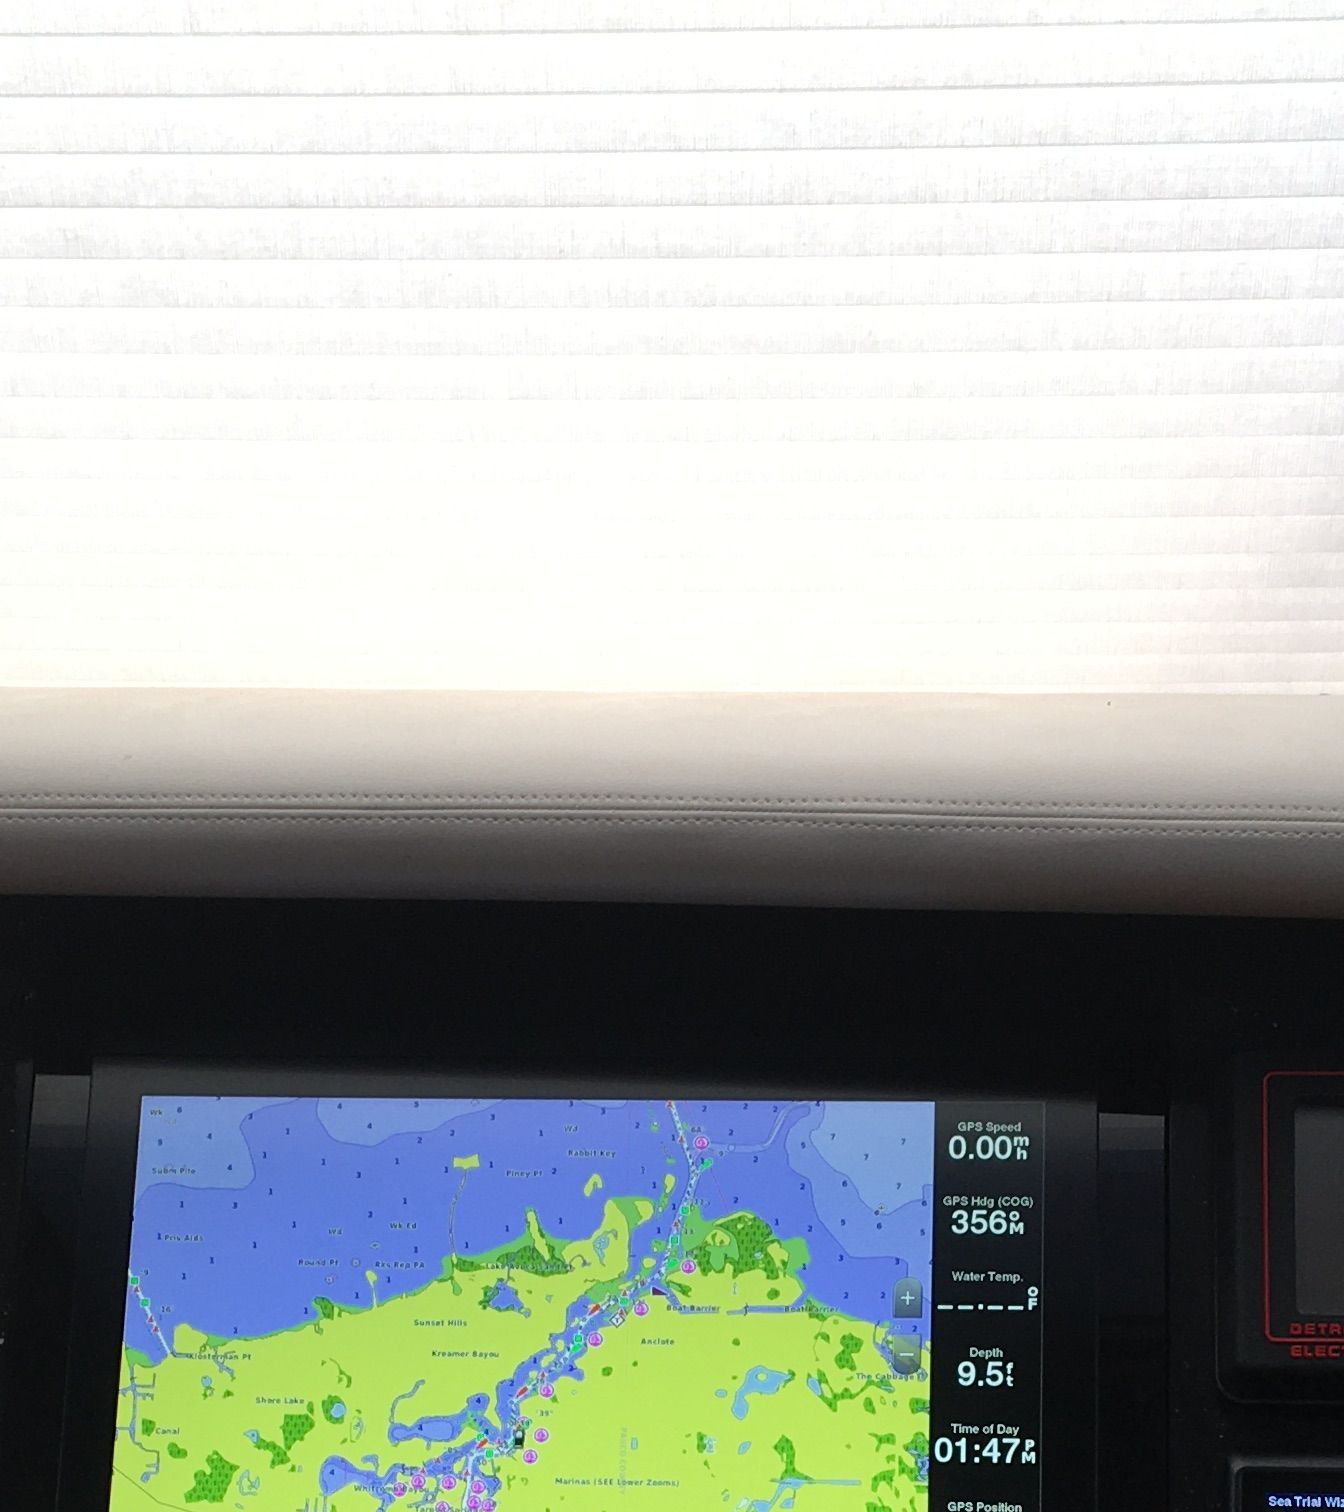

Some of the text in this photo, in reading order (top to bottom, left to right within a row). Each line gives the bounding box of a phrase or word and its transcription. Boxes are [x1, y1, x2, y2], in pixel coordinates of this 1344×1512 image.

[958, 1122, 1021, 1134] GPS Speed
[943, 1196, 1033, 1208] GPS Hdg (COG)
[952, 1272, 1023, 1283] Water Temp.
[414, 1319, 467, 1327] Sunset Hills
[472, 1350, 499, 1358] Bayou
[970, 1348, 1003, 1359] Depth
[951, 1423, 1019, 1436] Time of Day
[934, 1438, 1020, 1463] 01:47
[555, 1477, 680, 1488] Marinas (SEE Lower Zooms)
[948, 1502, 1022, 1512] GPS Position
[1268, 1496, 1292, 1507] Sea
[1294, 1497, 1321, 1508] Trial
